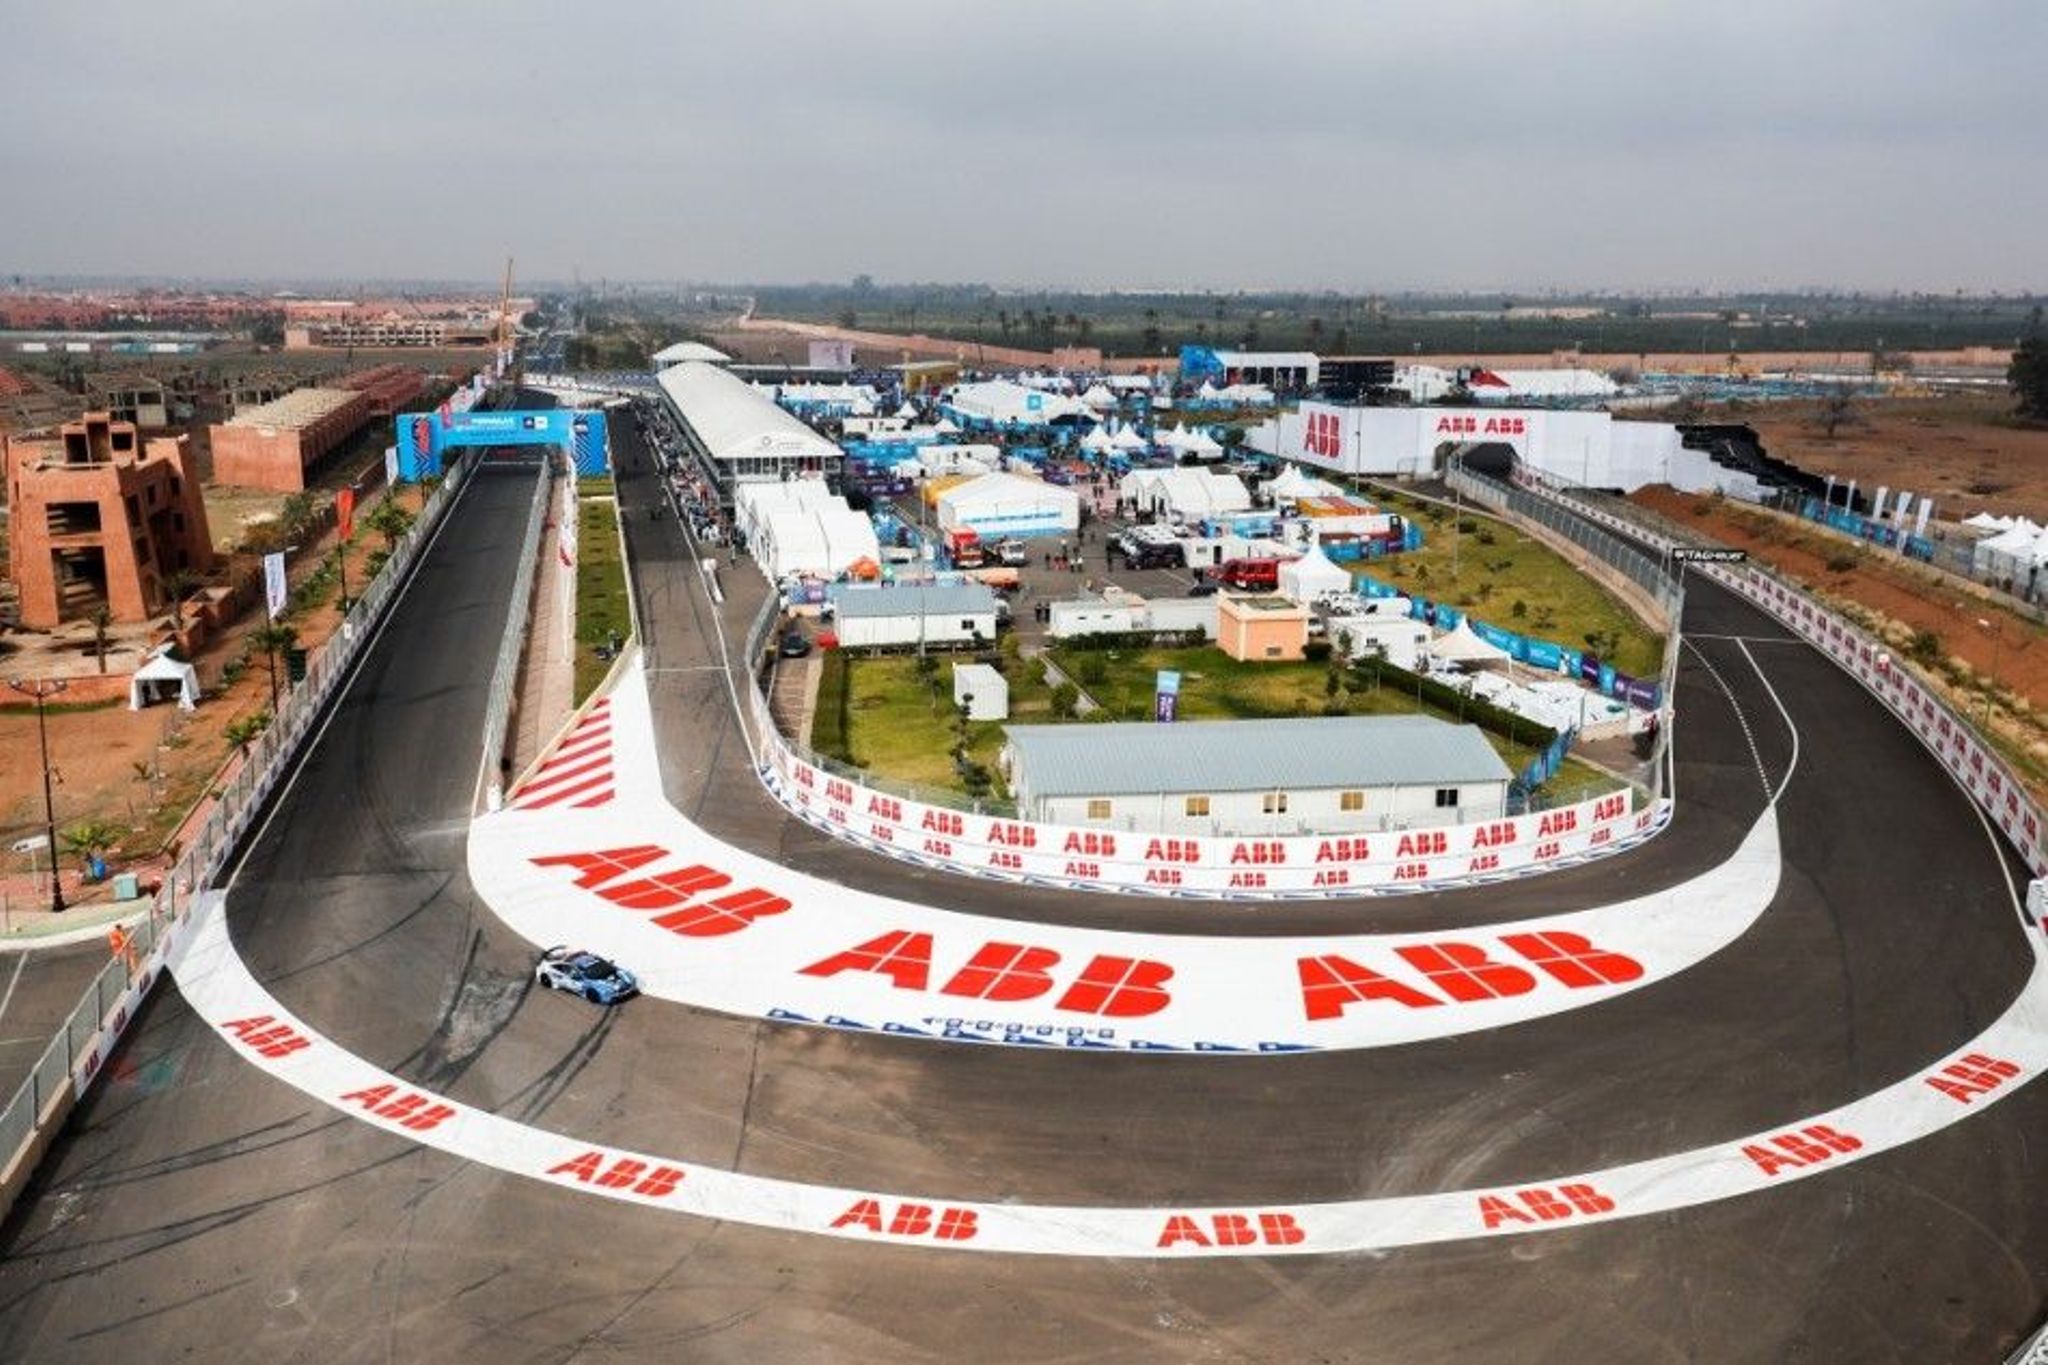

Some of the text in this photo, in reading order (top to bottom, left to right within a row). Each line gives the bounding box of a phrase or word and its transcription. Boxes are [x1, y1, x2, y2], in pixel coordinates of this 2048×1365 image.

[1304, 411, 1340, 458] ABB
[1437, 417, 1524, 434] ABB ABB
[826, 779, 852, 805] ABB
[868, 795, 902, 821] ABB
[922, 810, 963, 836] ABB
[987, 823, 1037, 848] ABB
[1064, 832, 1116, 857] ABB
[1145, 839, 1200, 863] ABB
[1231, 842, 1286, 864] ABB
[1315, 839, 1369, 862] ABB
[1396, 831, 1447, 857] ABB
[1473, 822, 1517, 848] ABB
[1538, 810, 1577, 837] ABB
[1593, 795, 1624, 823] ABB
[924, 839, 951, 856] ABB
[989, 852, 1022, 868] ABB
[1065, 862, 1100, 878] ABB
[1145, 869, 1182, 885] ABB
[1230, 872, 1266, 887] ABB
[1313, 870, 1349, 885] ABB
[1394, 864, 1428, 880] ABB
[1469, 855, 1499, 872] ABB
[1534, 843, 1560, 860] ABB
[530, 843, 1645, 1022] ABB ABB ABB
[220, 1015, 2021, 1249] ABB ABB ABB ABB ABB ABB ABB ABB
